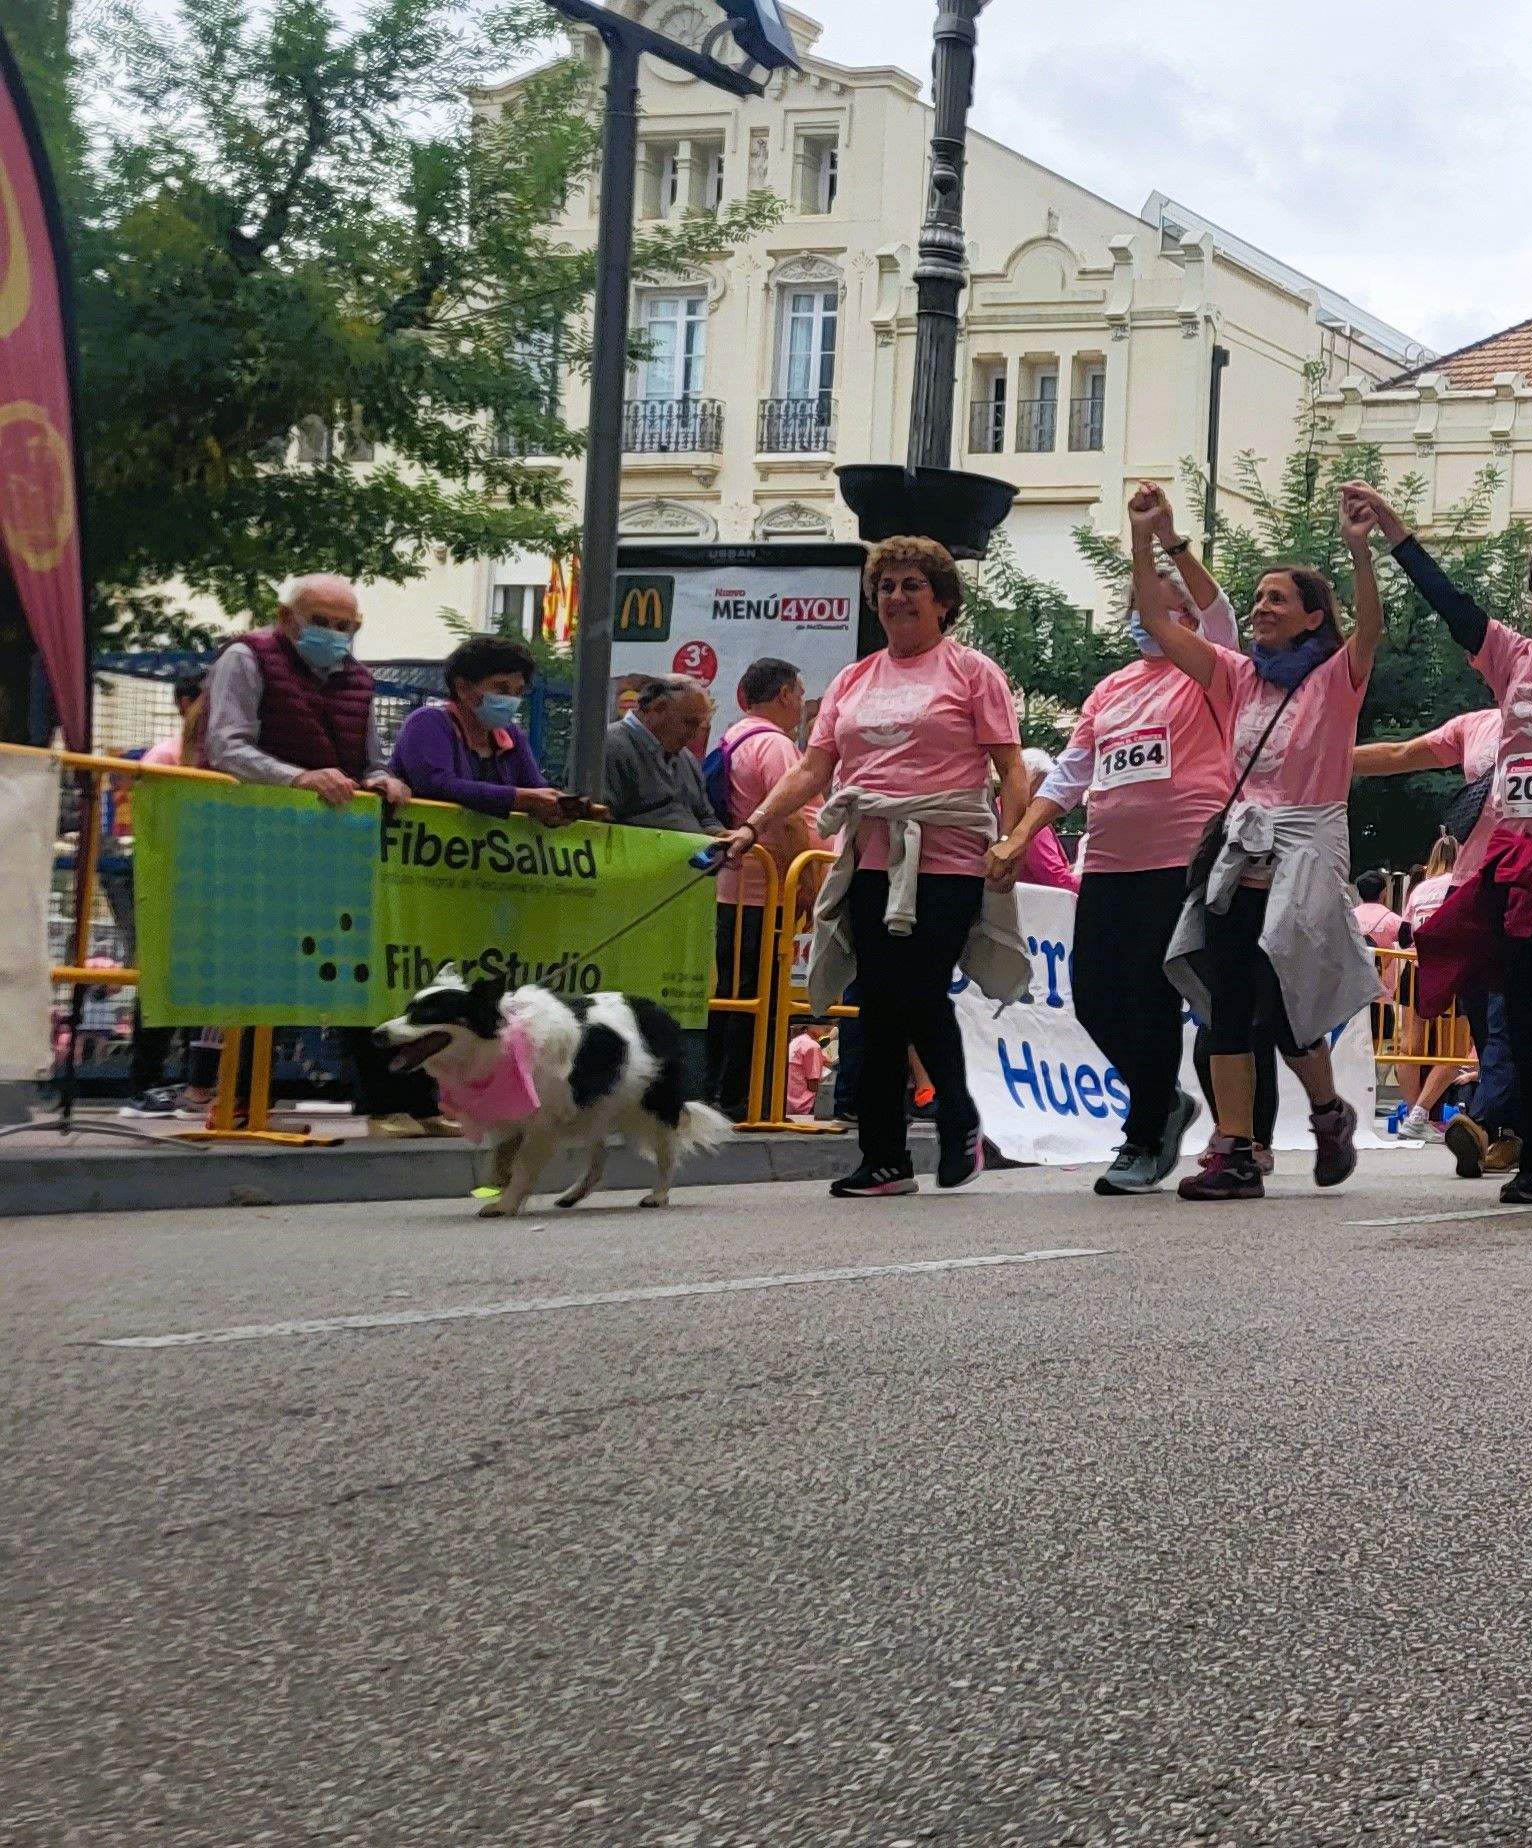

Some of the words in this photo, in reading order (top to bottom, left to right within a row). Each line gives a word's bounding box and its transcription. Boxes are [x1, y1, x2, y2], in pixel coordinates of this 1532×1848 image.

[712, 593, 780, 620] MENÚ
[714, 587, 746, 598] Nuevo
[1103, 743, 1165, 775] 1864
[380, 818, 598, 880] FiberSalud
